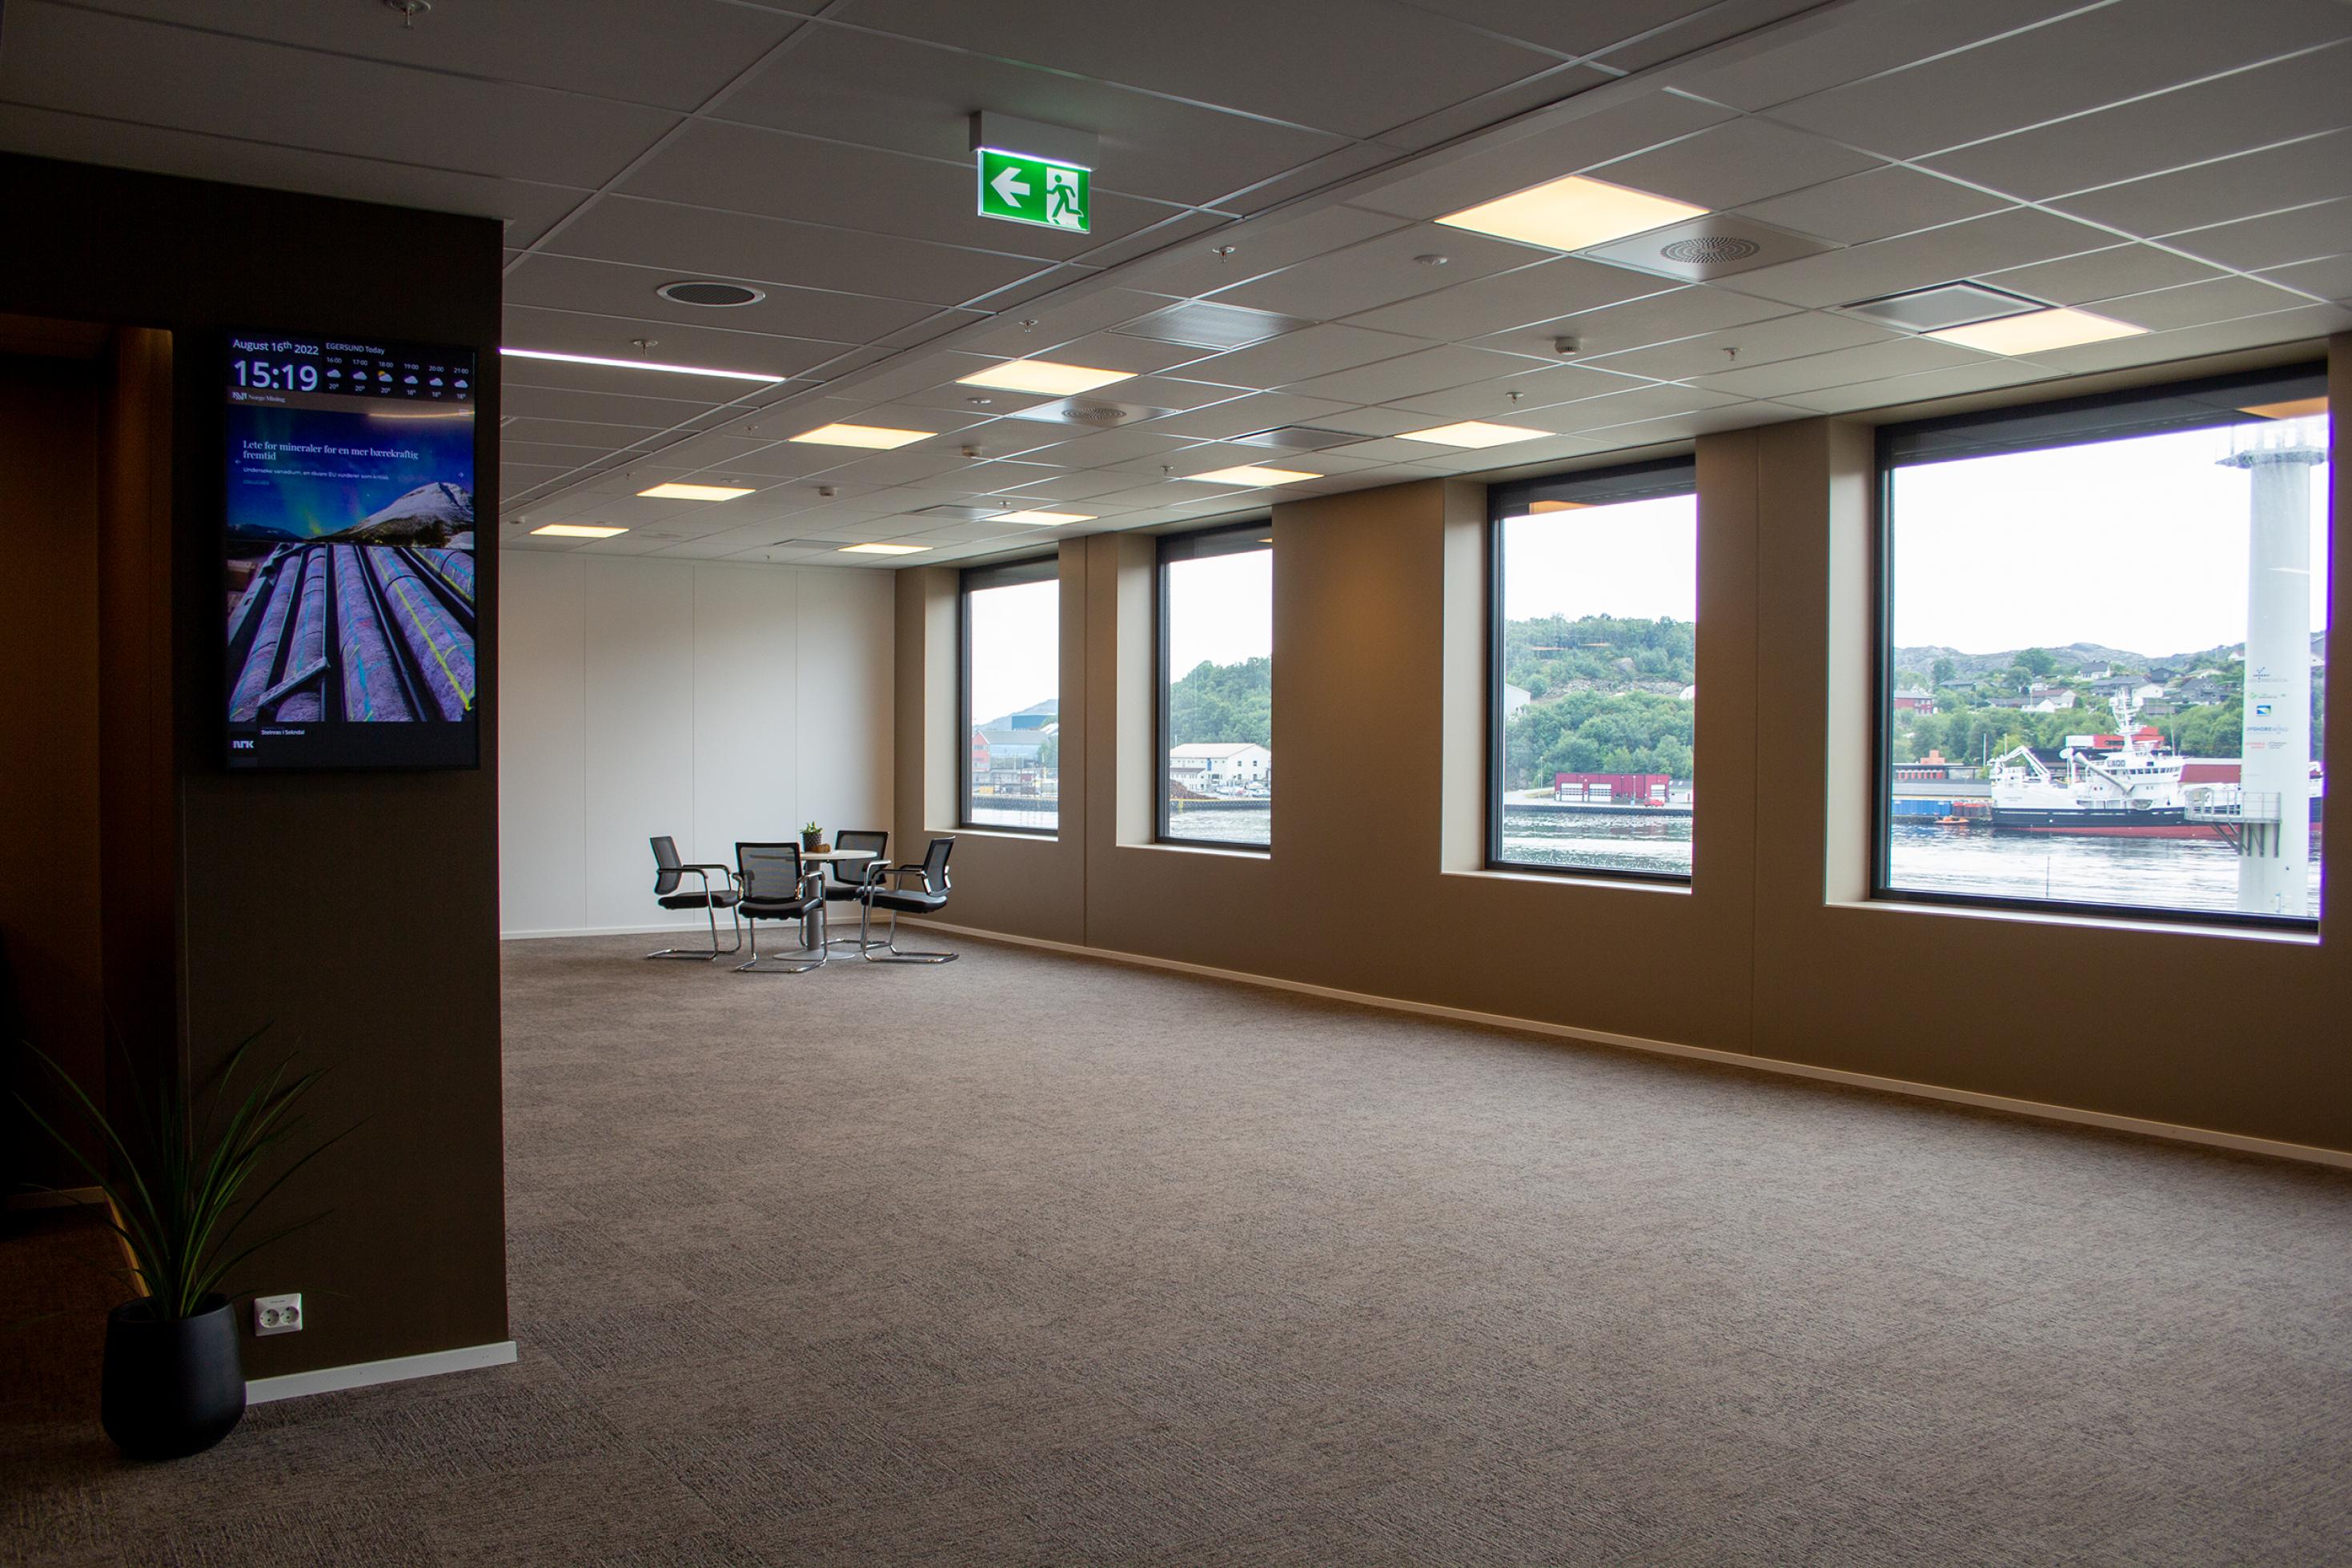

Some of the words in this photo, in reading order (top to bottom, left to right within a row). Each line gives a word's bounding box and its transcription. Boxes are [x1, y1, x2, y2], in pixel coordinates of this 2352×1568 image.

[233, 339, 269, 351] August
[295, 344, 319, 355] 2022
[326, 343, 364, 352] EGERSUND
[365, 346, 385, 355] Today
[235, 360, 318, 391] 15:19
[243, 440, 263, 449] Lete
[264, 441, 278, 450] for
[279, 443, 323, 453] mineraler
[324, 445, 337, 454] for
[351, 448, 369, 456] mer
[370, 448, 419, 461] bærekraftig
[243, 450, 276, 460] fremtid
